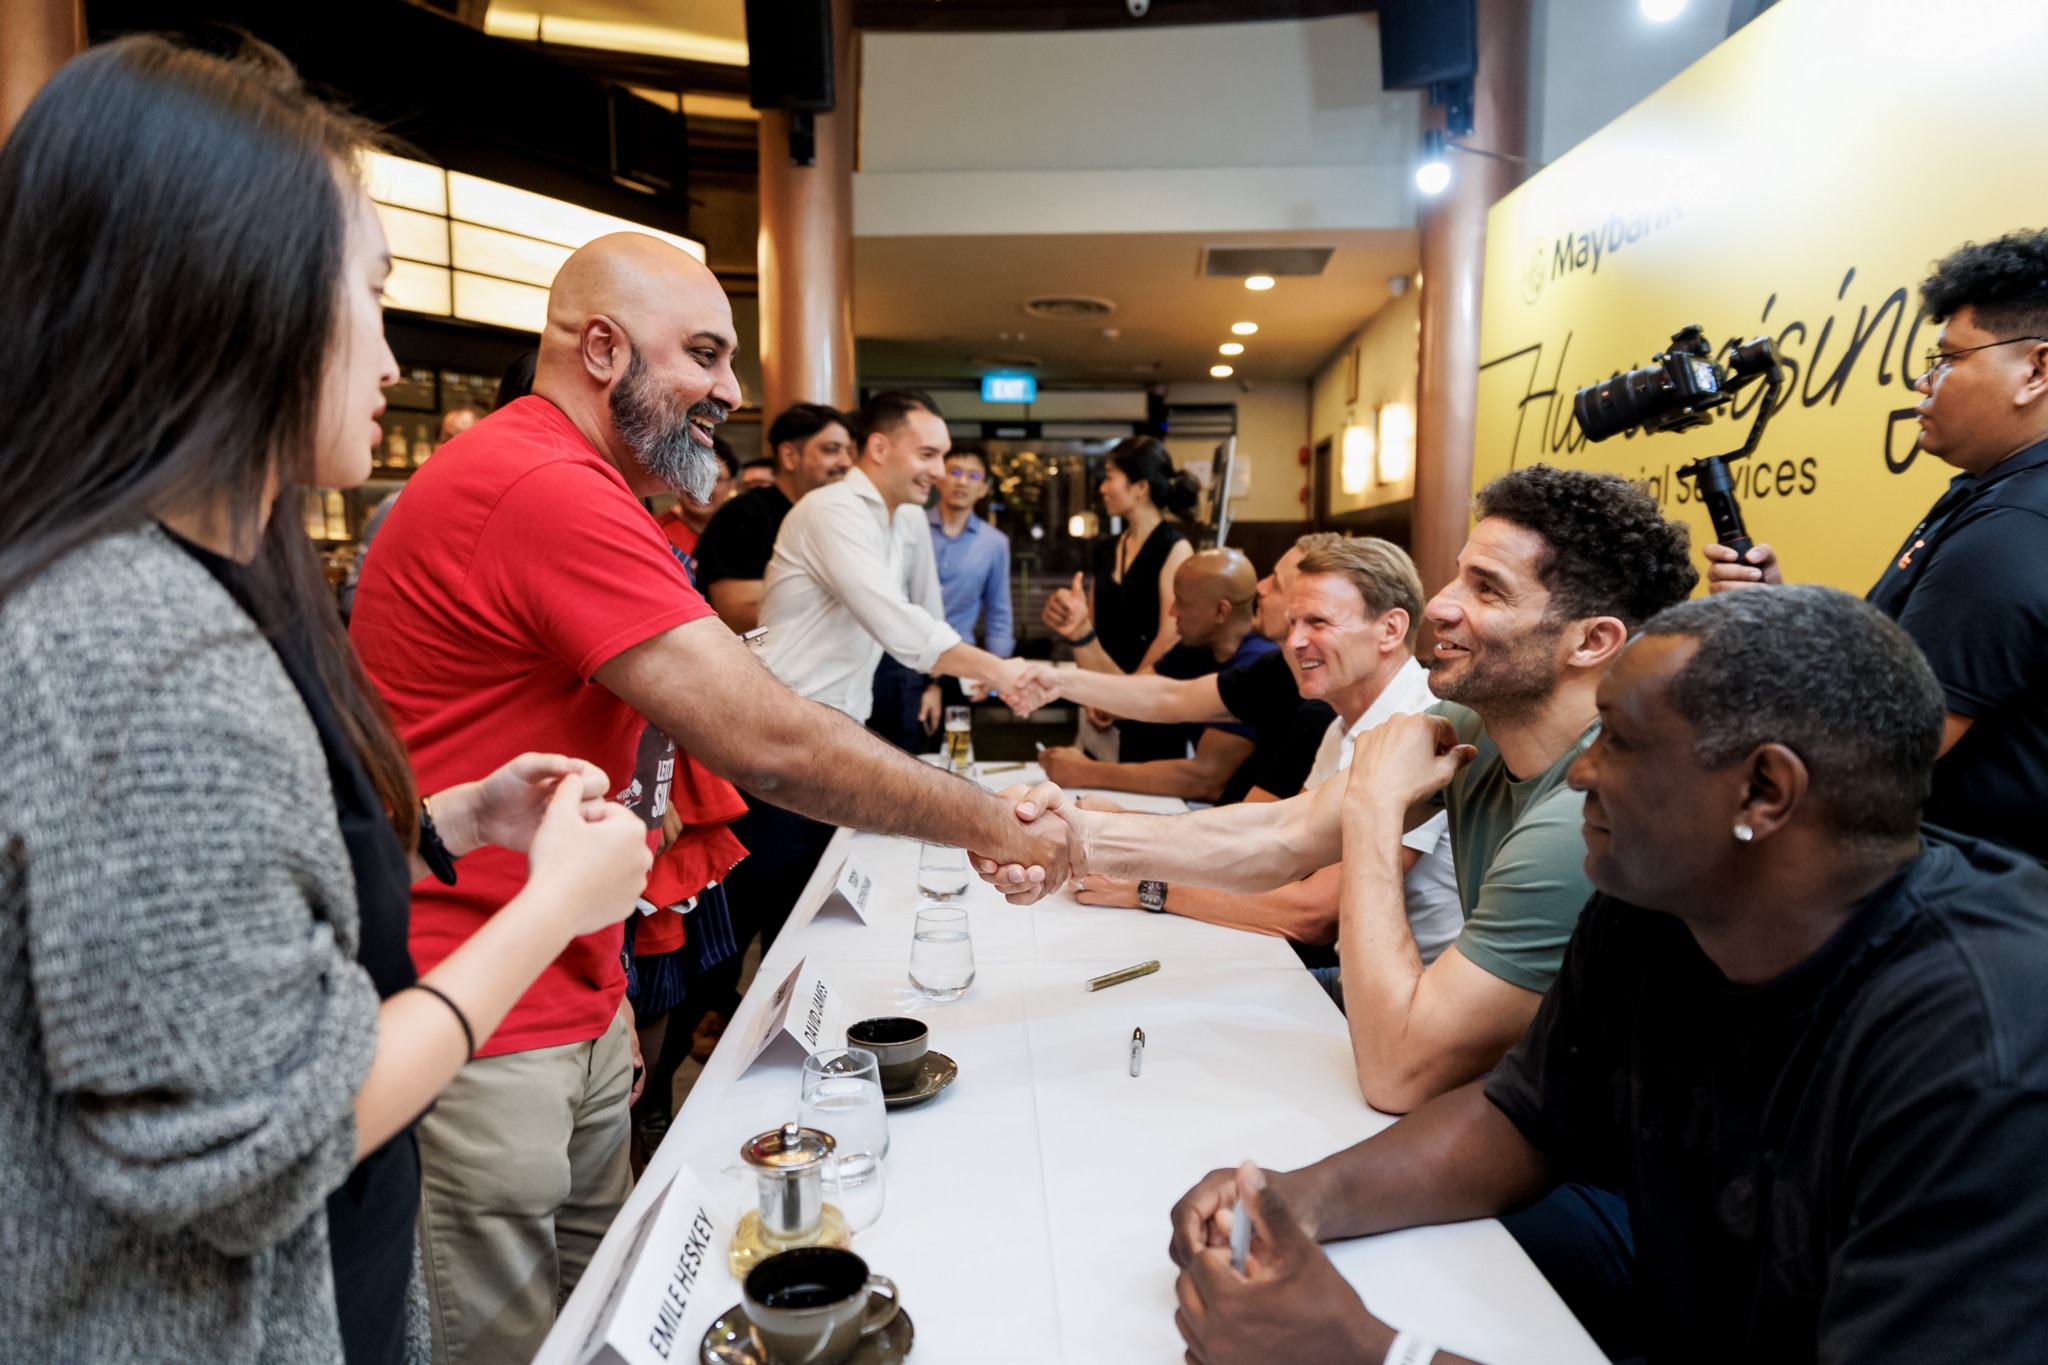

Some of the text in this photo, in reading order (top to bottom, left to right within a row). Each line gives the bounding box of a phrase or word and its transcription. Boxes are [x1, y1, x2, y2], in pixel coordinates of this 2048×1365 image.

[804, 979, 829, 1048] DAVID JAMES
[649, 1206, 715, 1361] EMILE HESKEY
